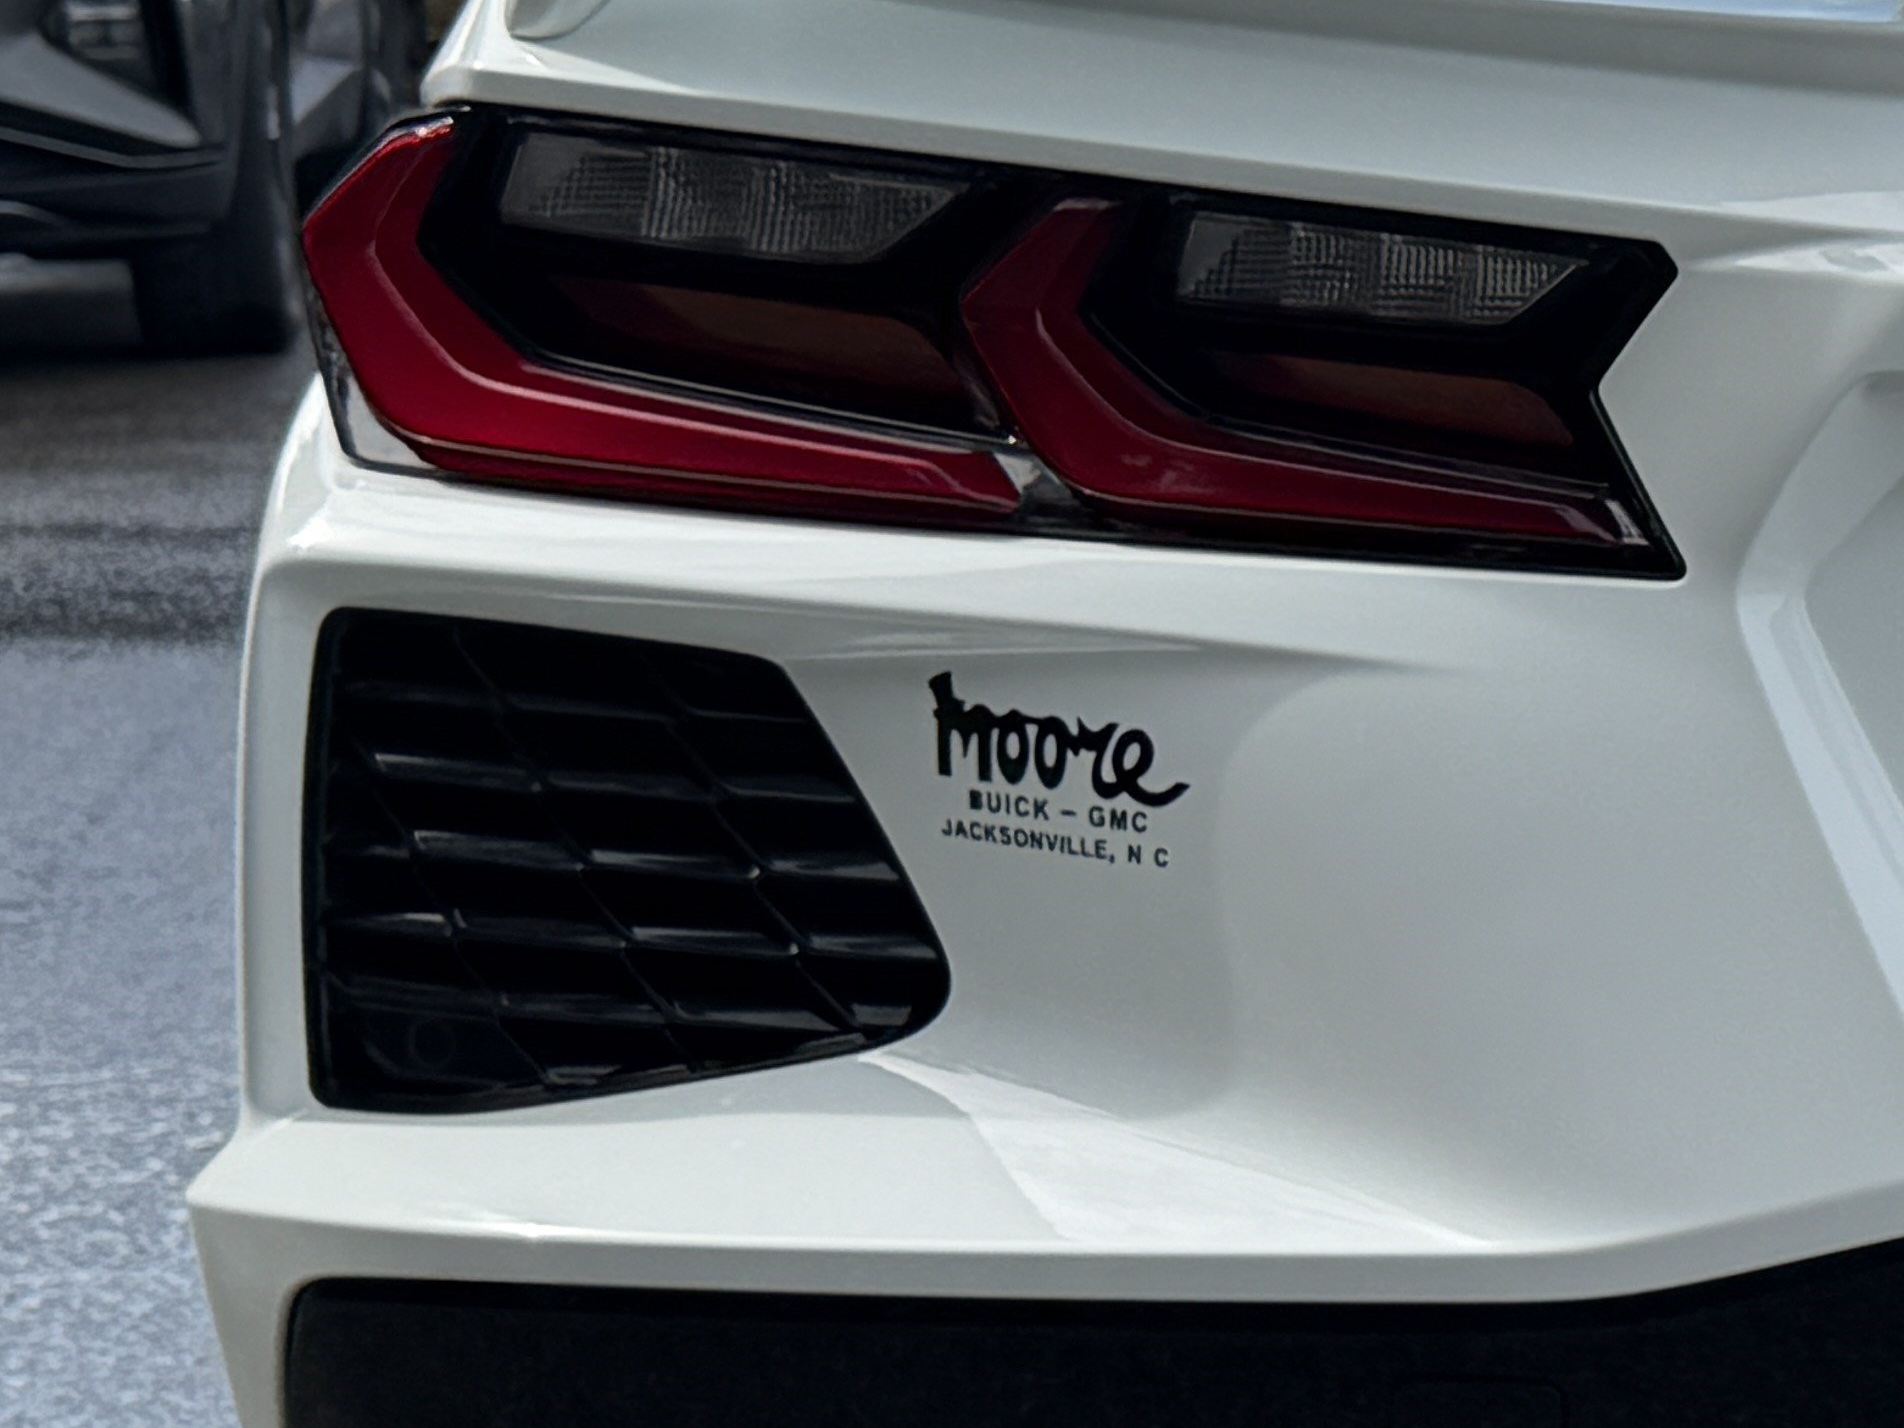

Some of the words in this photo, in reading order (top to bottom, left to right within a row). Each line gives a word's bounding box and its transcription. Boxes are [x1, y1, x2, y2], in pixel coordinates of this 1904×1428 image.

[969, 789, 1049, 821] BUICK
[1088, 805, 1148, 833] GMC
[941, 819, 1116, 864] JACKSONVILLE,
